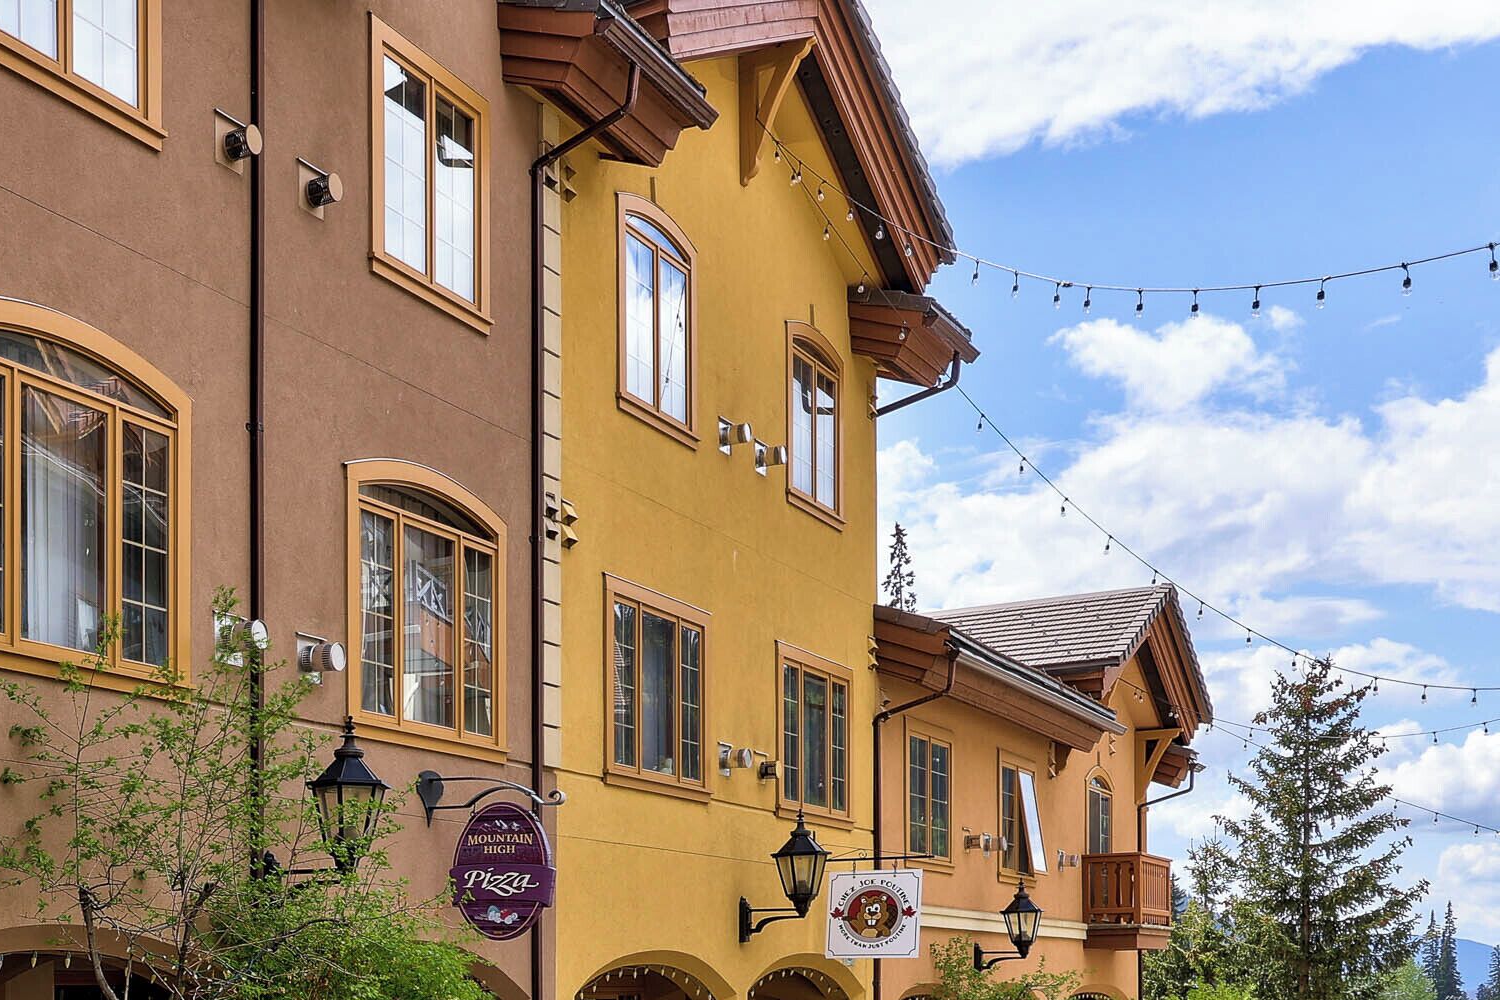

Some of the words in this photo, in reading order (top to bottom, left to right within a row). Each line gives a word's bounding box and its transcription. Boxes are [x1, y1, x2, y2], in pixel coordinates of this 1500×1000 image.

[467, 833, 534, 846] MOUNTAIN
[483, 844, 516, 854] HIGH
[462, 867, 540, 897] Pizza
[838, 886, 857, 907] CHEZ
[859, 878, 877, 888] JOE
[880, 878, 911, 906] POUTINE
[838, 923, 850, 940] MORE
[850, 939, 867, 949] THAN
[884, 923, 907, 945] POUTINE
